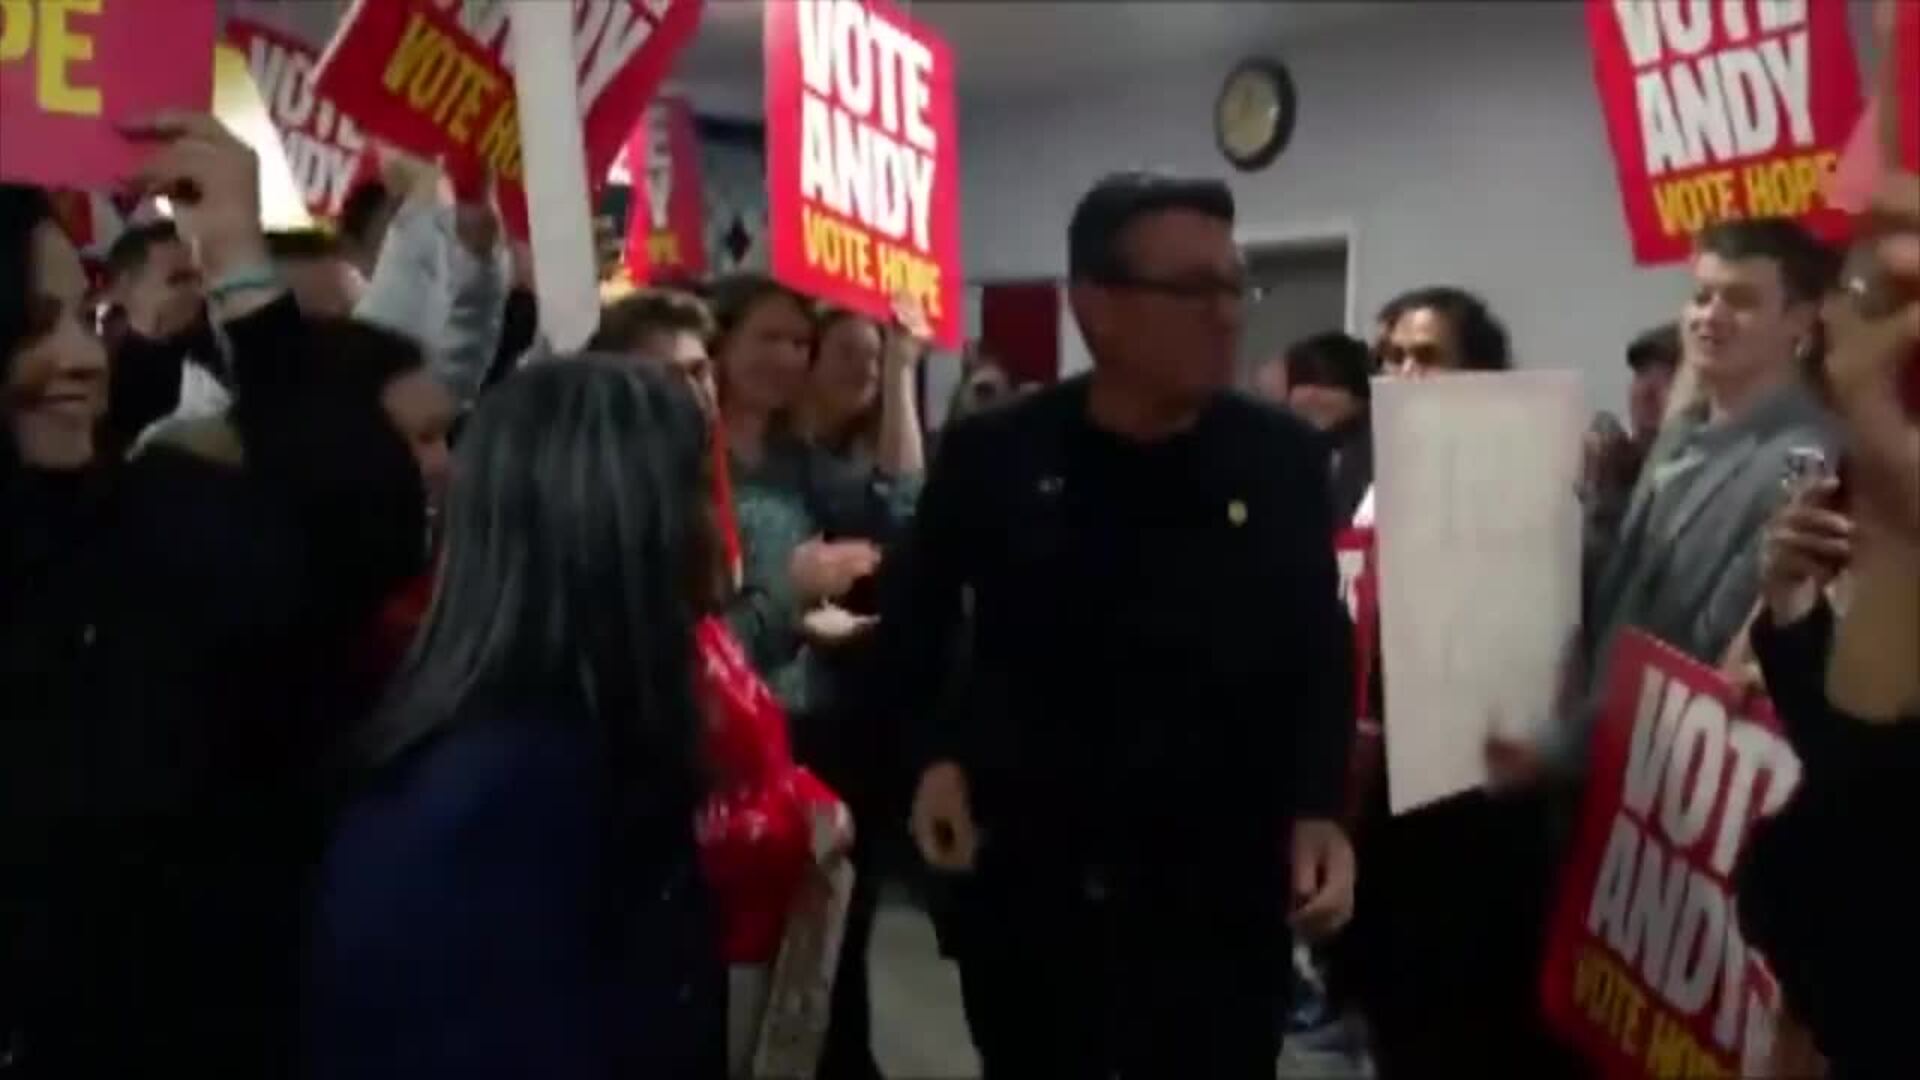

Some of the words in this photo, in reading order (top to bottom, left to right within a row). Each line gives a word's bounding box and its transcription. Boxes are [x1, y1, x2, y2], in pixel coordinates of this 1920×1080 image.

[0, 0, 102, 114] PE
[382, 13, 500, 144] VOTE
[797, 0, 938, 150] VOTE
[1635, 32, 1815, 176] ANDY
[801, 90, 936, 252] ANDY
[1653, 170, 1738, 236] VOTE
[802, 204, 875, 289] VOTE
